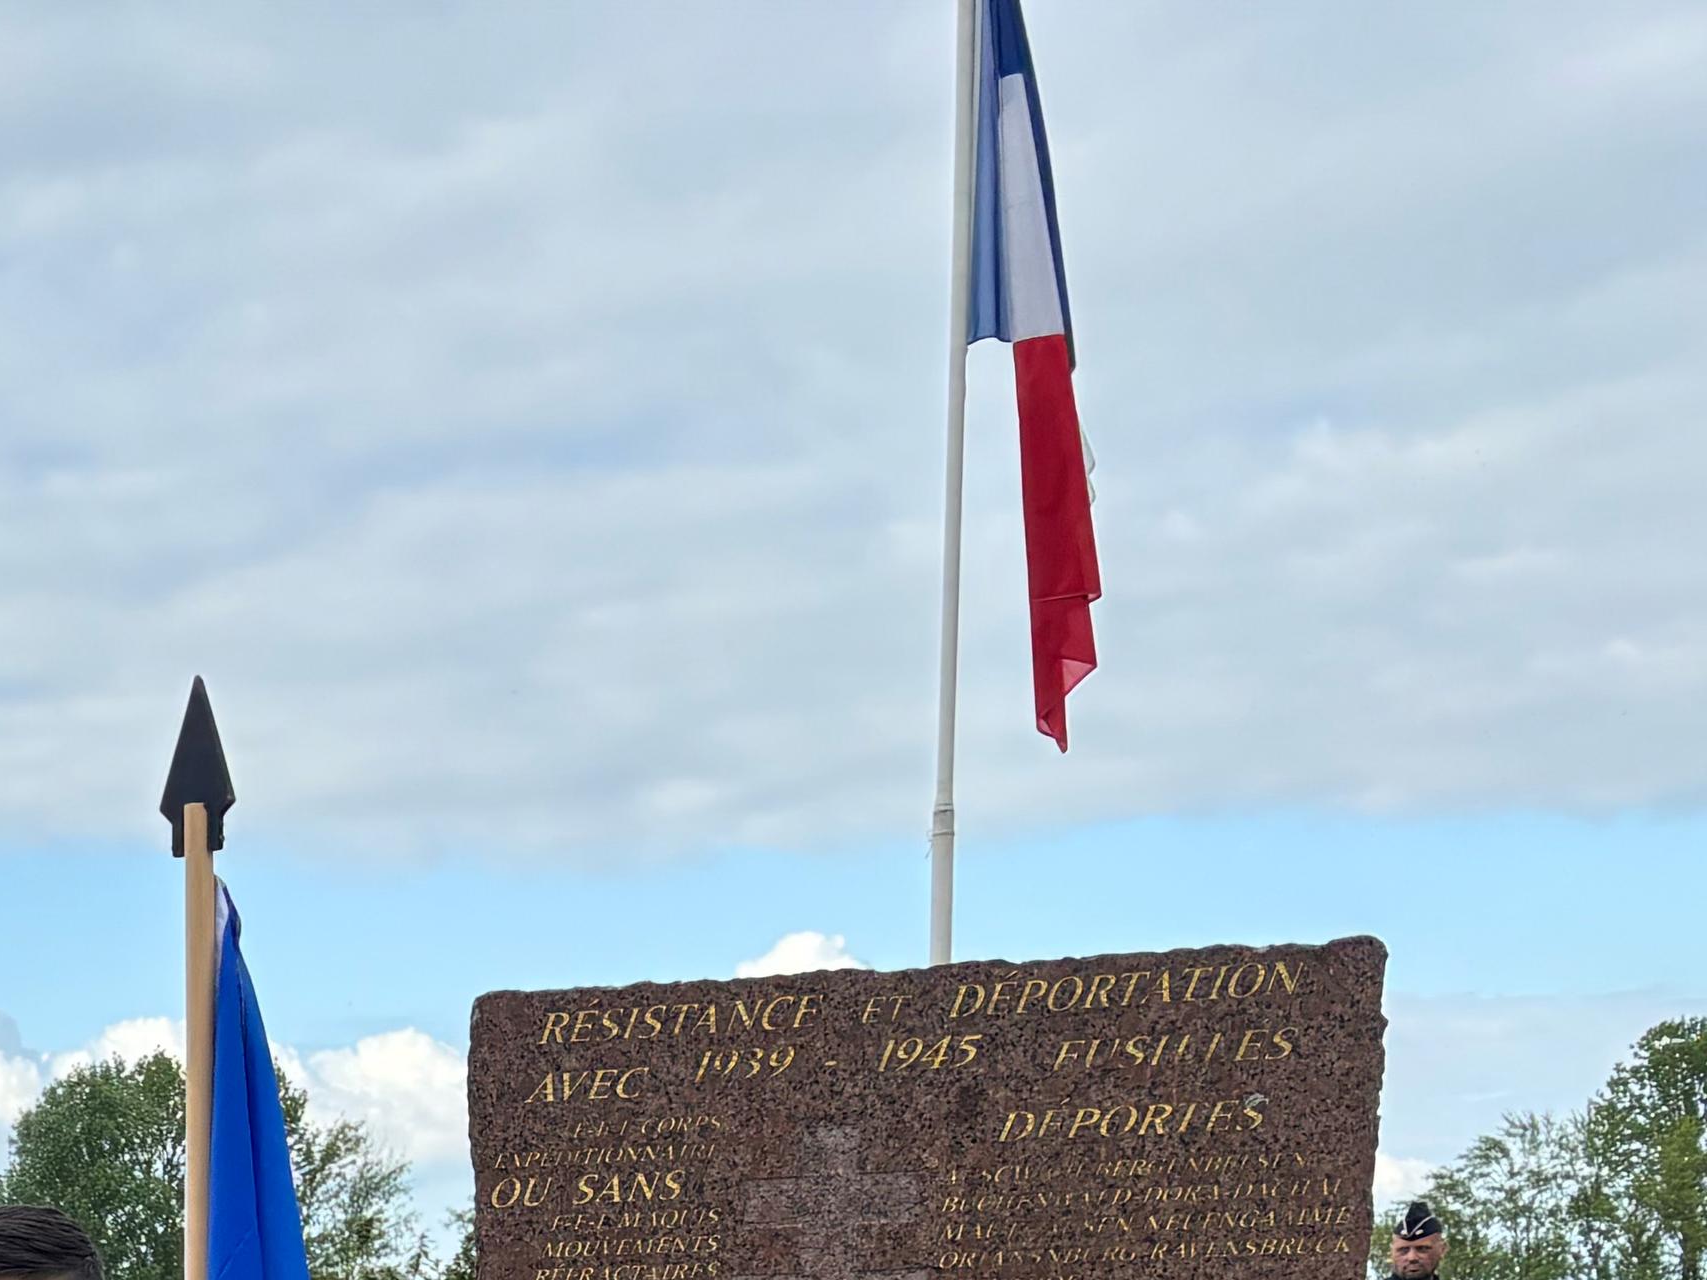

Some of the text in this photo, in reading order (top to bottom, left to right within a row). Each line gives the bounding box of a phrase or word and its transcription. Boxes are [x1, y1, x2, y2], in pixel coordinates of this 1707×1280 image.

[538, 961, 1306, 1045] RÉSISTANCE ET DÉPORTATION
[695, 1045, 797, 1084] 1939
[877, 1033, 984, 1073] 1945
[524, 1066, 650, 1104] AVEC
[491, 1168, 687, 1209] OU SANS
[541, 1234, 722, 1259] MOUVEMENTS
